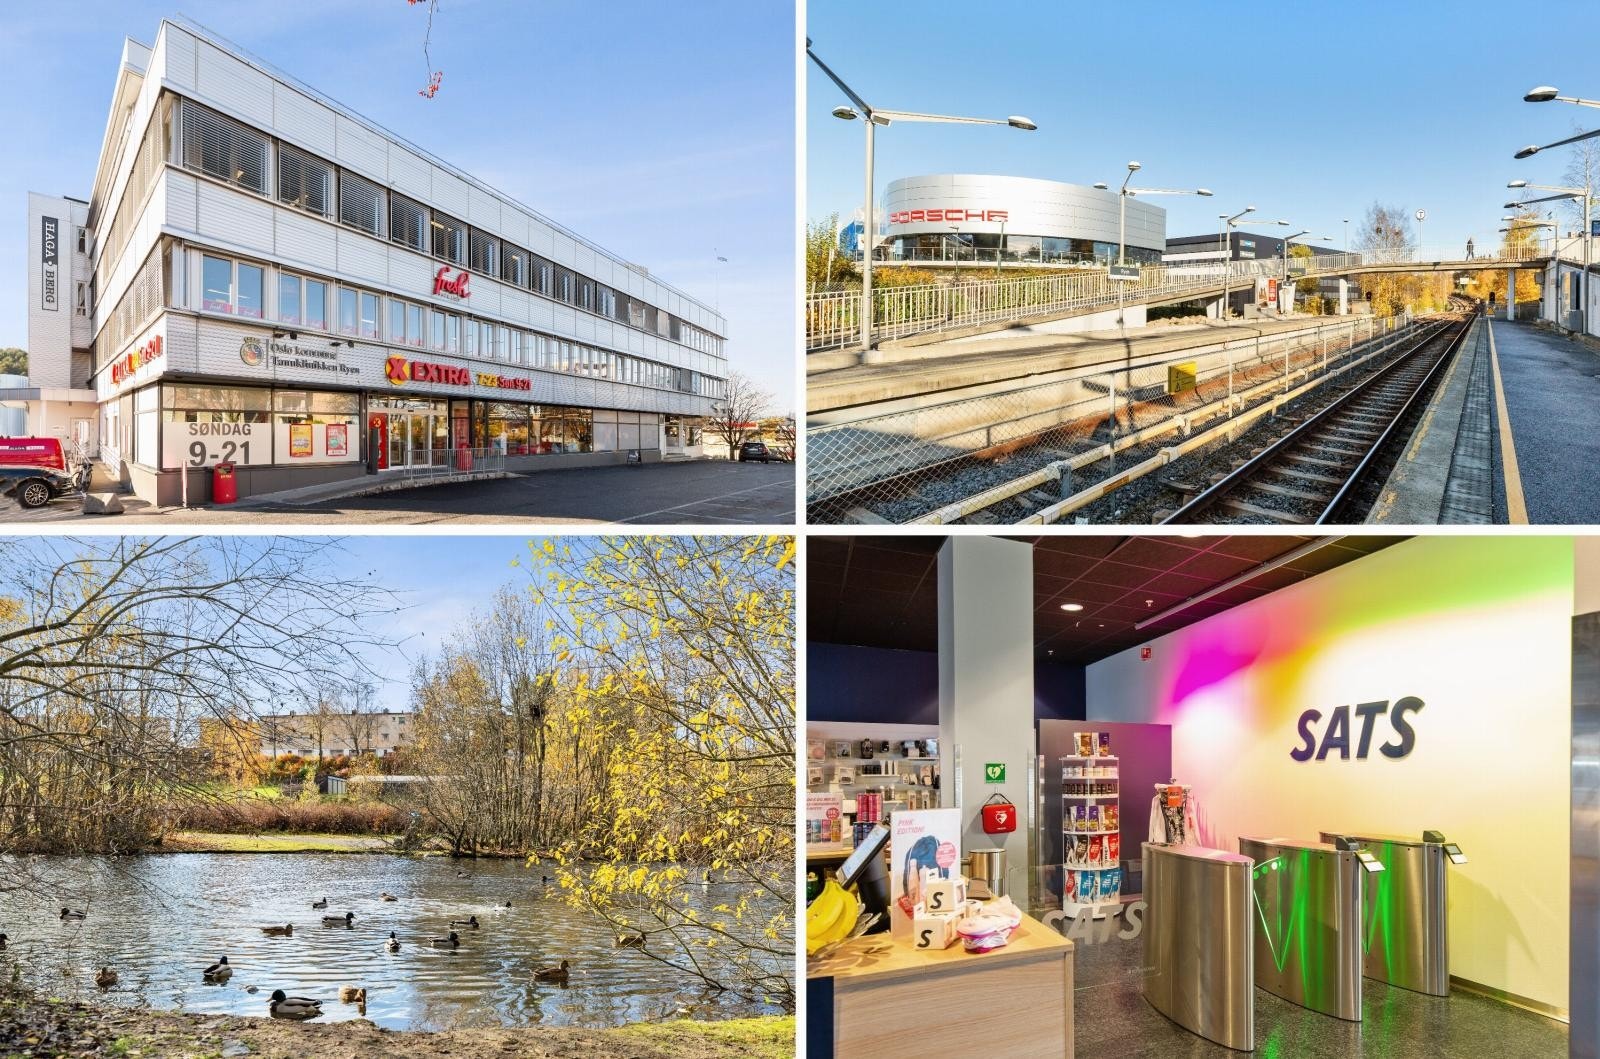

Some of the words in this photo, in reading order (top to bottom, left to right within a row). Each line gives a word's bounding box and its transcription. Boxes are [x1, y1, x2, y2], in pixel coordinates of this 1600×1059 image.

[889, 209, 1008, 223] PORSCHE
[45, 222, 55, 258] HAGA
[45, 269, 55, 303] BERG
[433, 266, 471, 298] fresh
[411, 361, 472, 386] EXTRA
[189, 422, 251, 436] SØNDAG
[189, 440, 251, 466] 9-21
[1289, 695, 1426, 763] SATS
[930, 891, 944, 910] S
[917, 929, 933, 948] S
